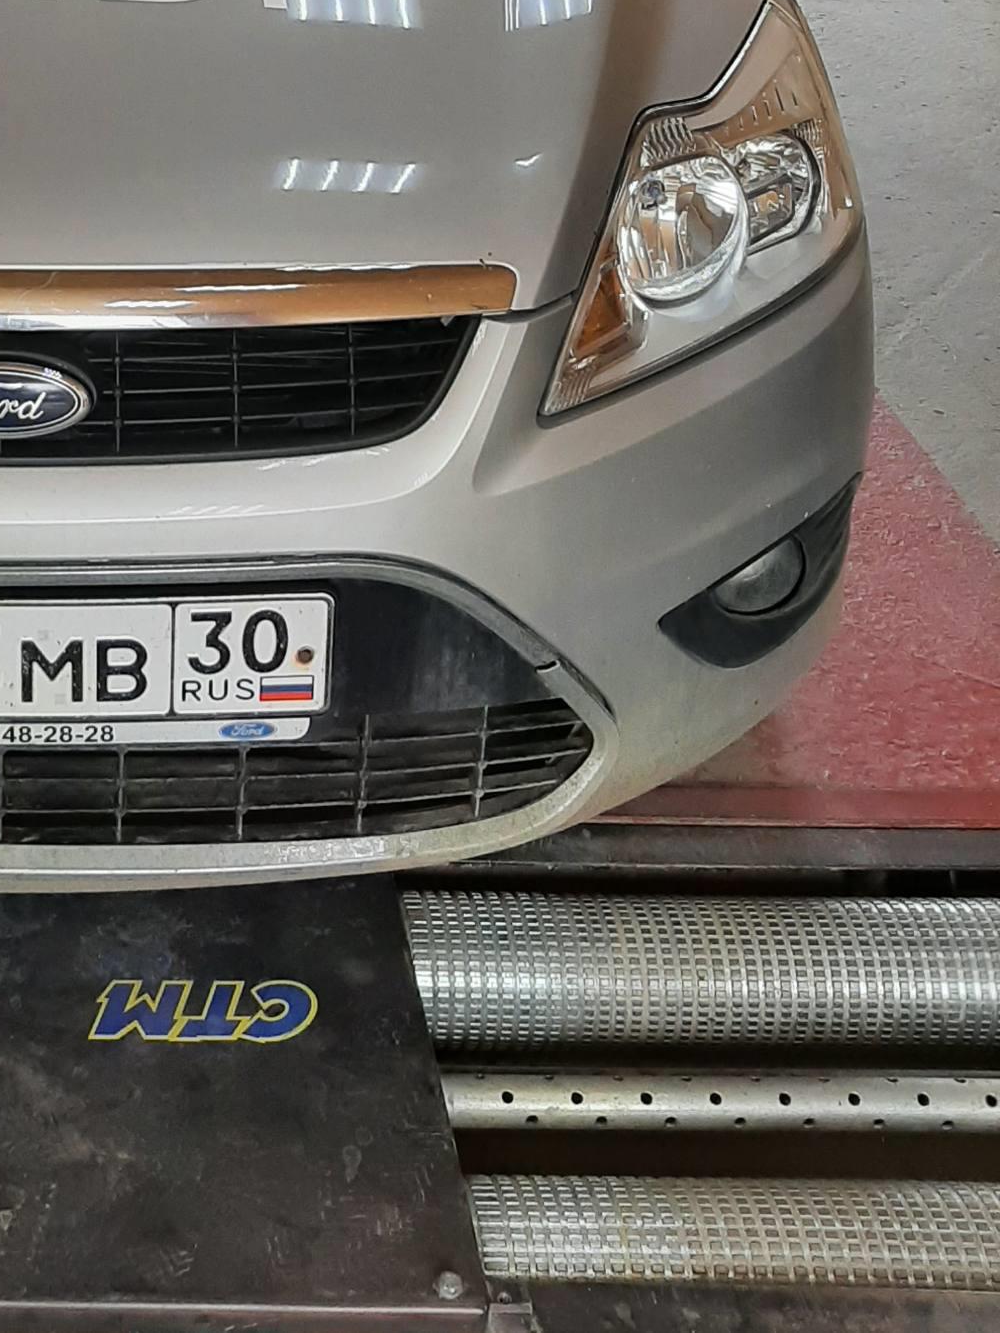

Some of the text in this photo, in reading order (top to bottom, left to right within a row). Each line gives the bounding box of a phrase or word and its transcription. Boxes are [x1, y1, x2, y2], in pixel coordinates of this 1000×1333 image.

[187, 610, 289, 675] 30
[181, 677, 254, 703] RUS
[1, 725, 115, 744] 48-28-28
[230, 722, 266, 737] Ford
